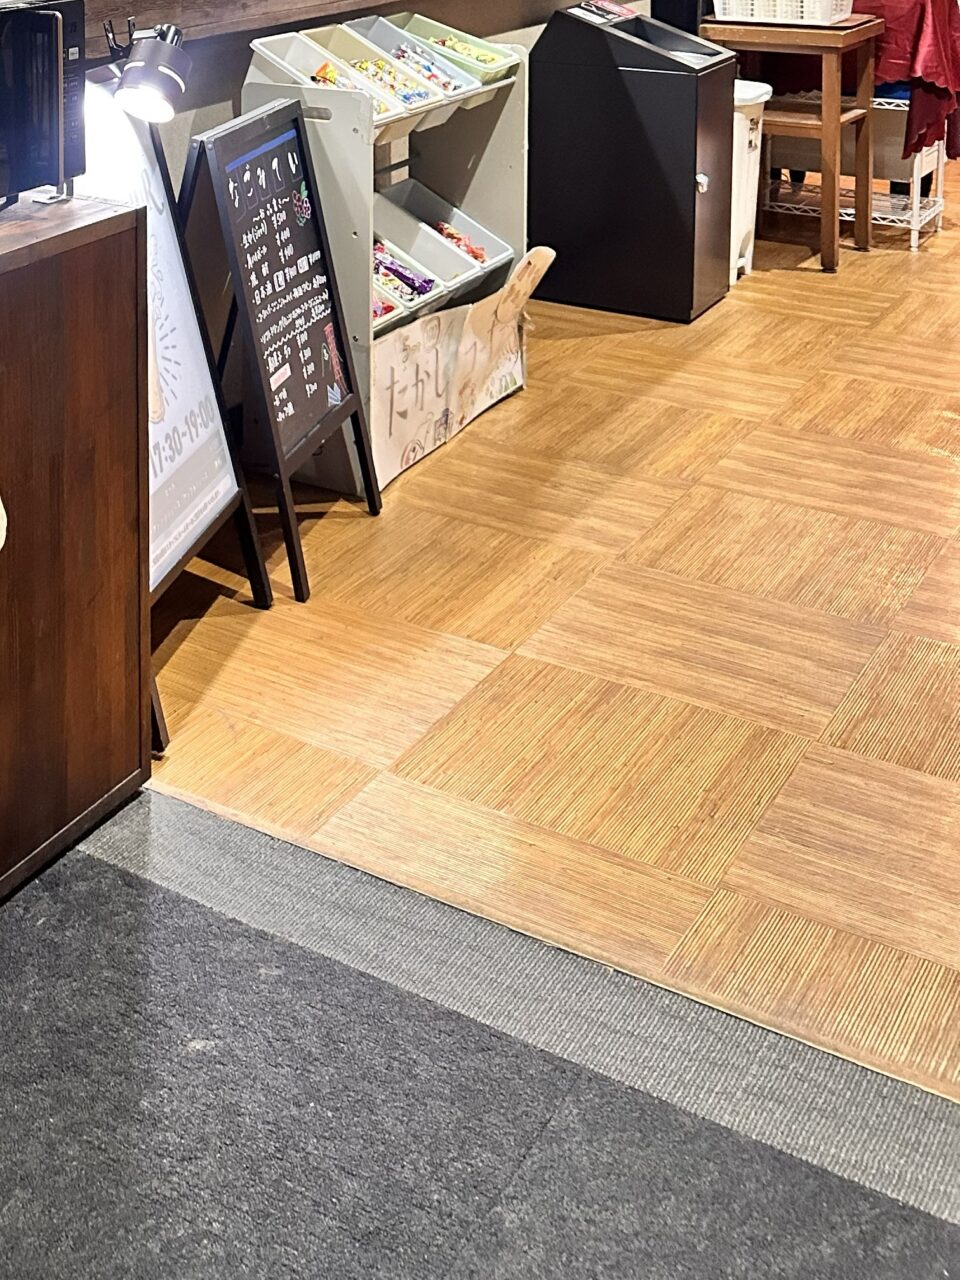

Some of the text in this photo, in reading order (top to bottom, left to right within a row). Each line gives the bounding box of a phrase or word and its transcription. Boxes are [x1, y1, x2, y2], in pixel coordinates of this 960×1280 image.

[228, 147, 299, 208] なごみてい
